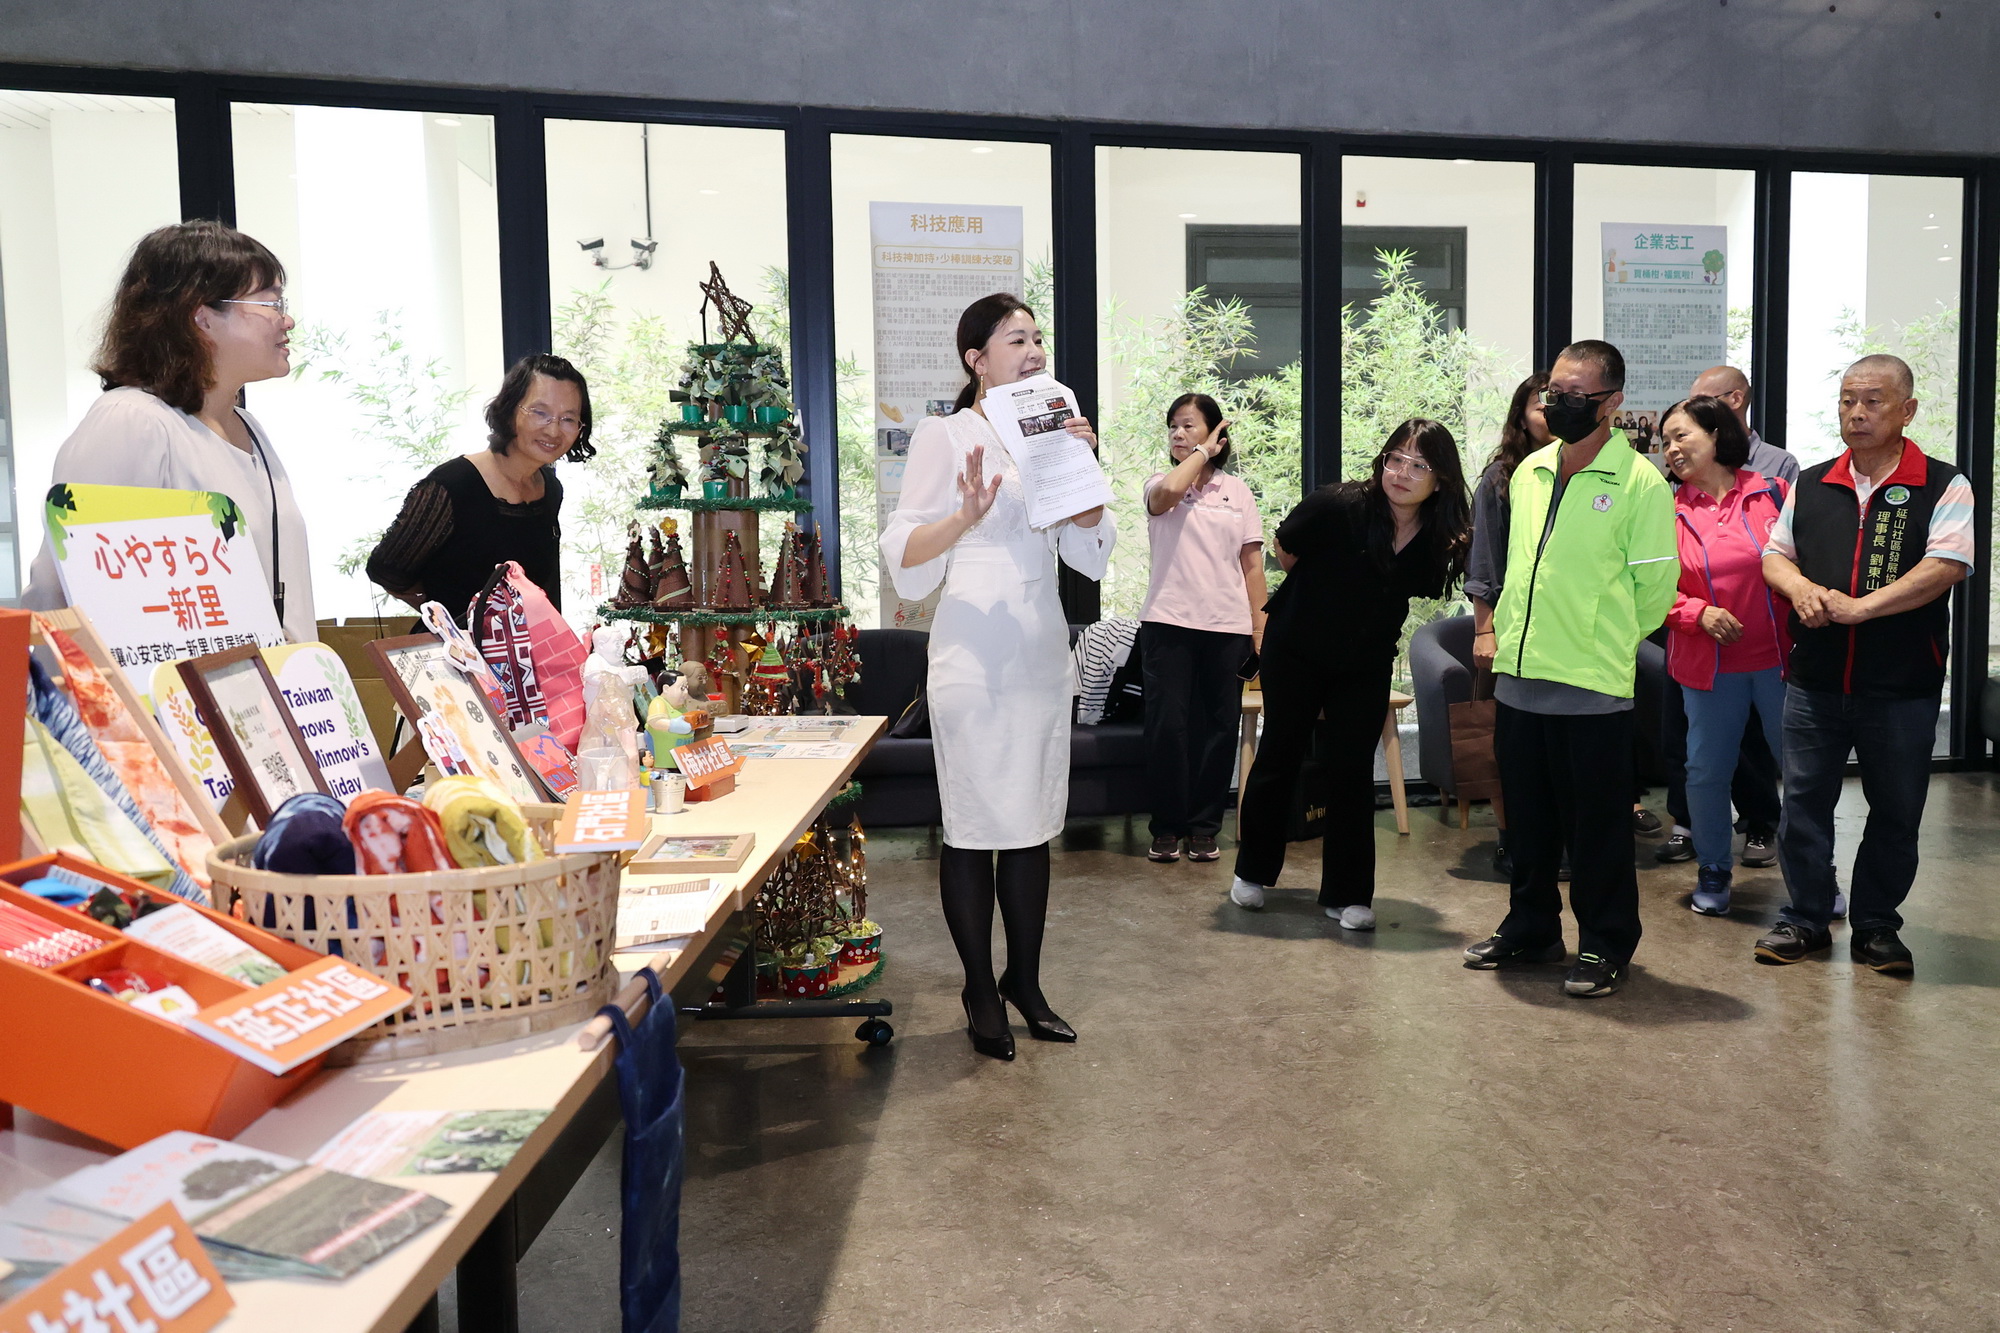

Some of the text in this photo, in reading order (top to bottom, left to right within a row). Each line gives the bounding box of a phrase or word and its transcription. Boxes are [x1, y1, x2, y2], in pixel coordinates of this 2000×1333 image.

[911, 214, 983, 234] 科技應用
[1634, 233, 1694, 250] 企業志工
[94, 532, 232, 580] 心やすらぐ
[142, 585, 229, 631] 一新里
[282, 687, 334, 708] Taiwan
[298, 719, 335, 739] nows
[680, 741, 735, 779] 梅村社區
[328, 776, 363, 799] liday
[213, 964, 391, 1051] 延正社區
[27, 1225, 212, 1333] 社區
